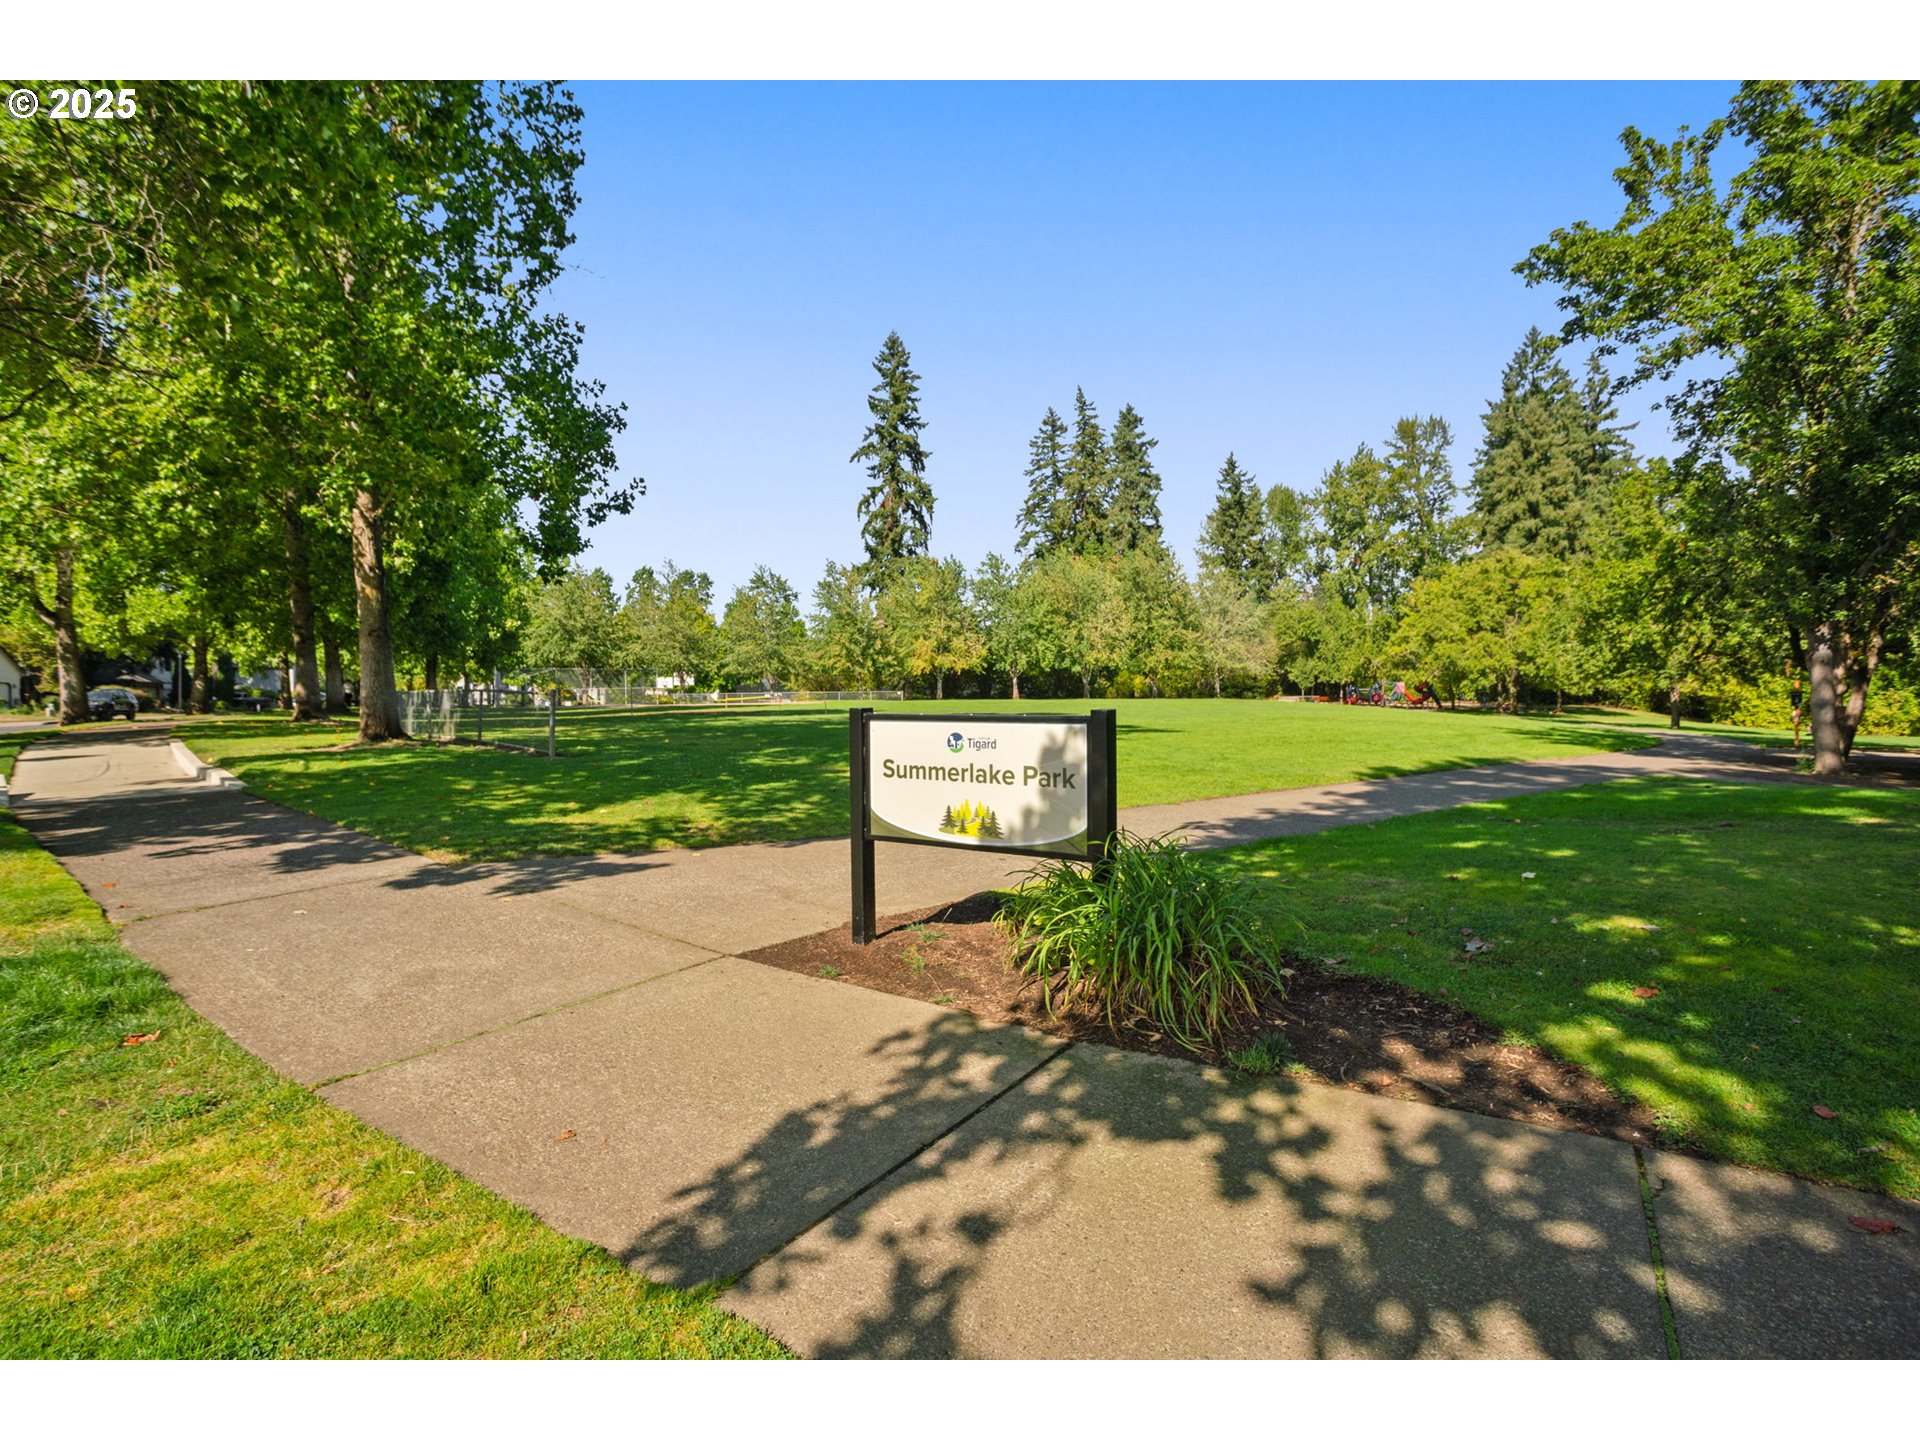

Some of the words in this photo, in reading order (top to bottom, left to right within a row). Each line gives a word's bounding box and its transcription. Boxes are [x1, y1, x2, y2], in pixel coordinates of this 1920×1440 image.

[967, 737, 997, 751] Tigard
[882, 758, 1015, 786] Summerlake
[1023, 765, 1076, 789] Park
